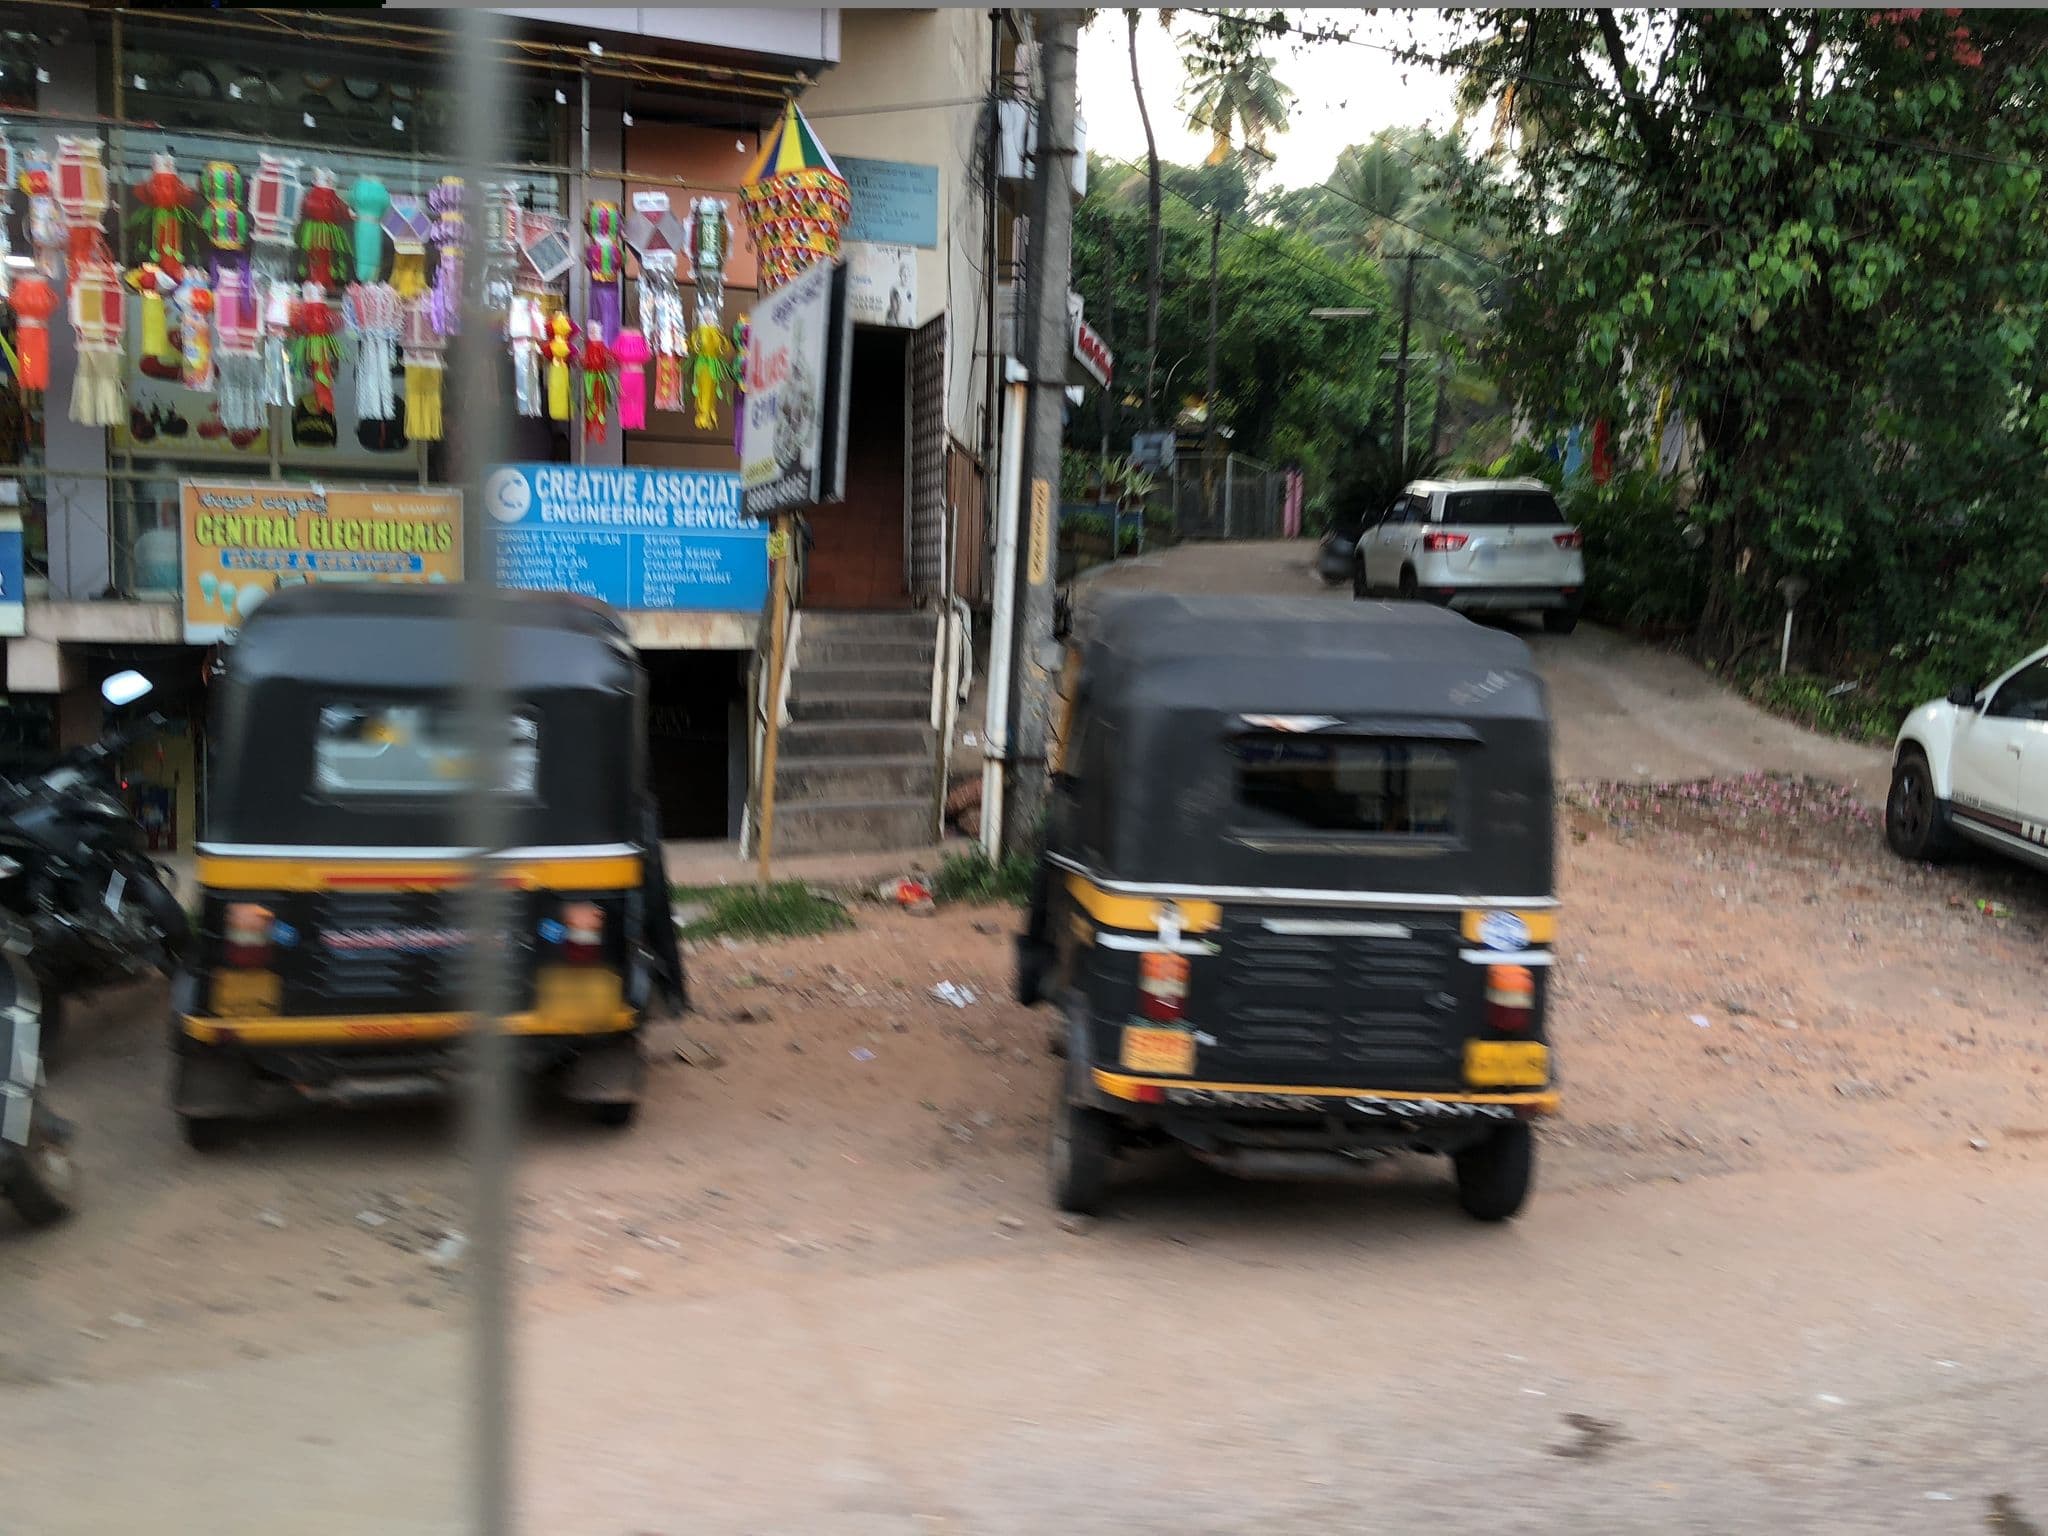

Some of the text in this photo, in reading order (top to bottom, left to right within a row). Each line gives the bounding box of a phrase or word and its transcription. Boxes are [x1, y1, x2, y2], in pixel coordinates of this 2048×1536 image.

[536, 469, 637, 504] CREATIVE
[641, 473, 742, 508] ASSOCIAT
[541, 501, 668, 528] ENGINEERING
[196, 513, 455, 553] CENTRAL ELECTRICALS
[589, 532, 621, 546] PLAN
[544, 544, 577, 557] PLAN
[643, 546, 722, 560] COLOR XEROX
[556, 556, 588, 569] PLAN
[643, 559, 717, 573] COLOR PRINT
[644, 570, 732, 584] AMMONIA PRINT
